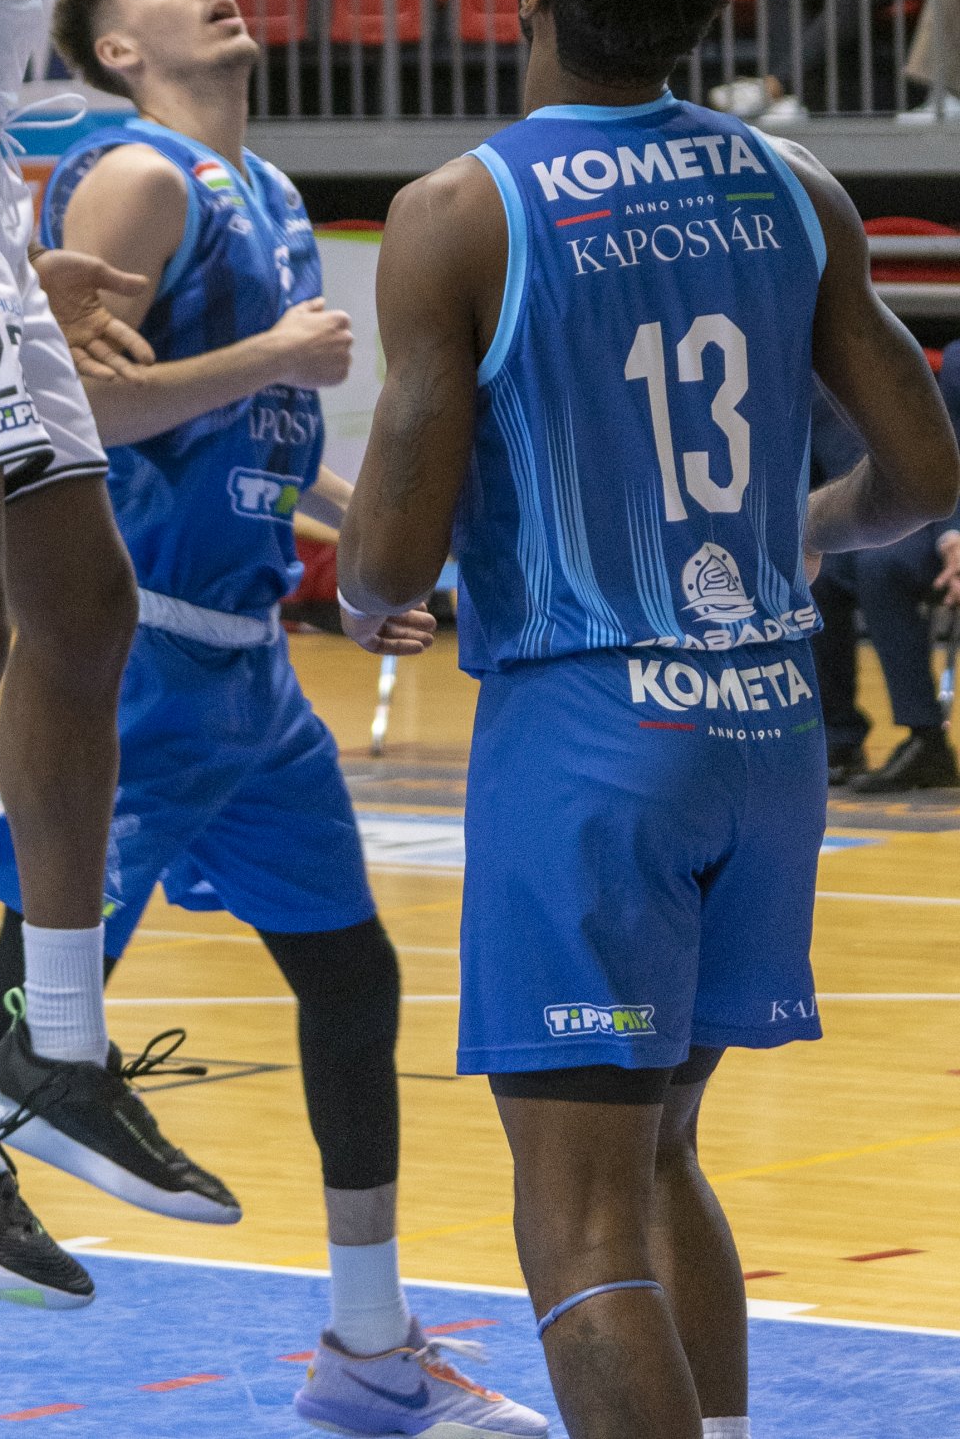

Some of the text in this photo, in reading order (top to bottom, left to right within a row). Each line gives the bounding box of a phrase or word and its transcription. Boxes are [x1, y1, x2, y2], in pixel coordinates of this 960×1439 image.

[531, 134, 768, 202] KOMETA
[625, 194, 715, 216] ANNO 1999
[567, 207, 782, 276] KAPOSVÁR
[624, 313, 750, 523] 13
[628, 659, 813, 711] KOMETA
[709, 726, 781, 740] ANNO 1999
